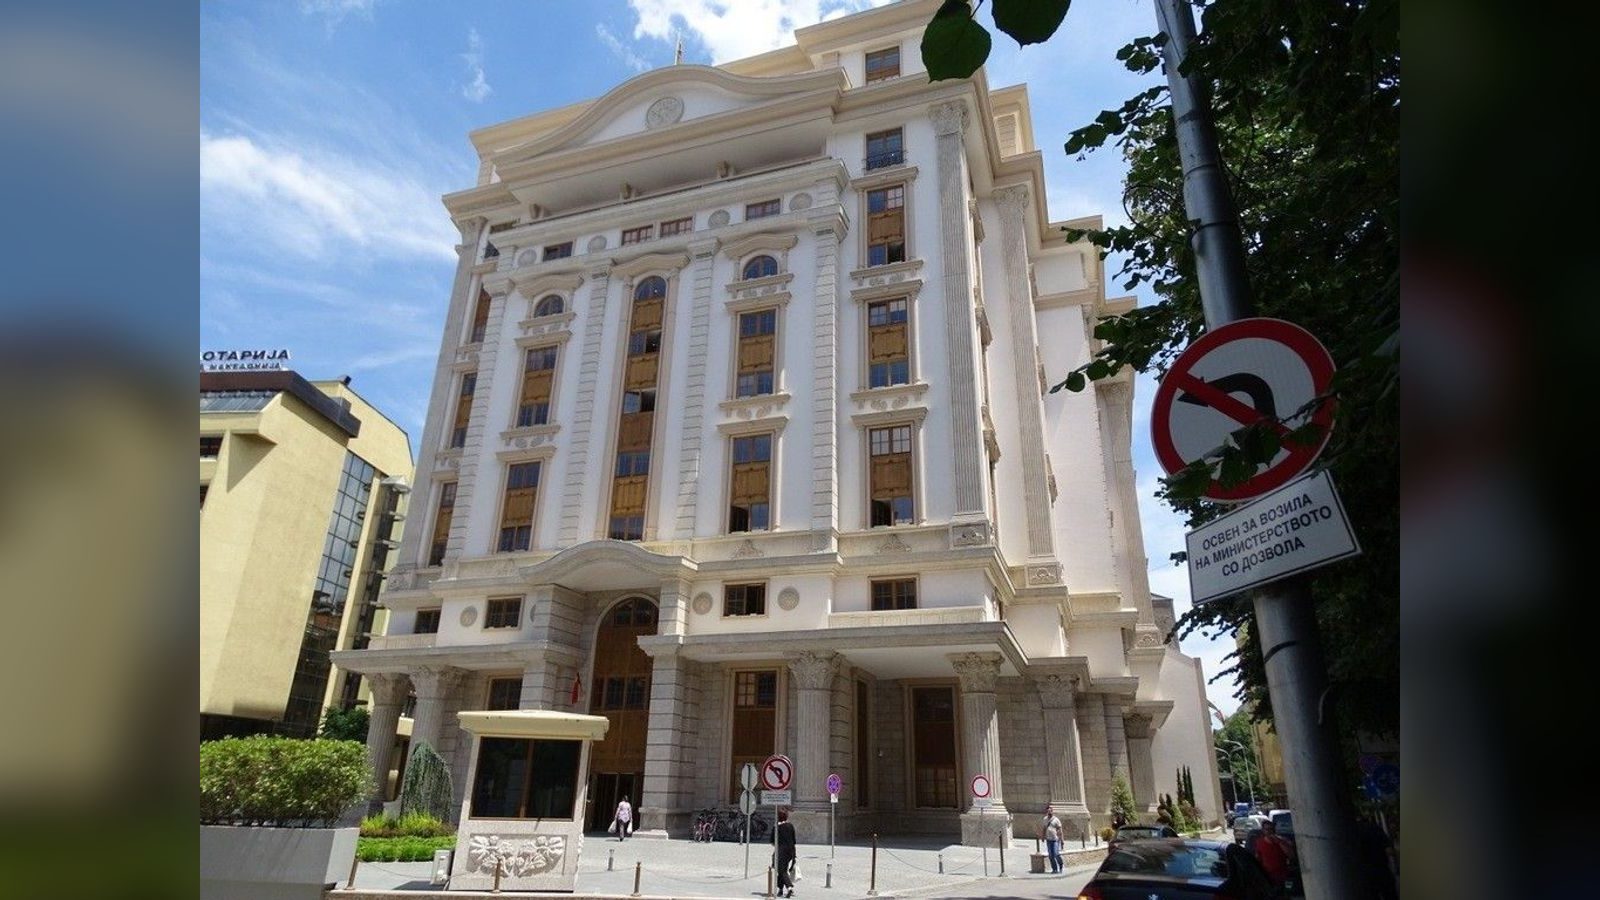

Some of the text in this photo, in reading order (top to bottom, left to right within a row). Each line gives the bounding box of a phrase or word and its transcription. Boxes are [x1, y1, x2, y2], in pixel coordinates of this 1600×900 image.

[202, 349, 289, 361] ОТАРИЈА
[1195, 505, 1332, 570] НА МИНИСТЕРСТВОТО
[1202, 493, 1313, 550] ОСВЕН ЗА ВОЗИЛА
[1222, 536, 1305, 577] СО ДОЗВОЛА
